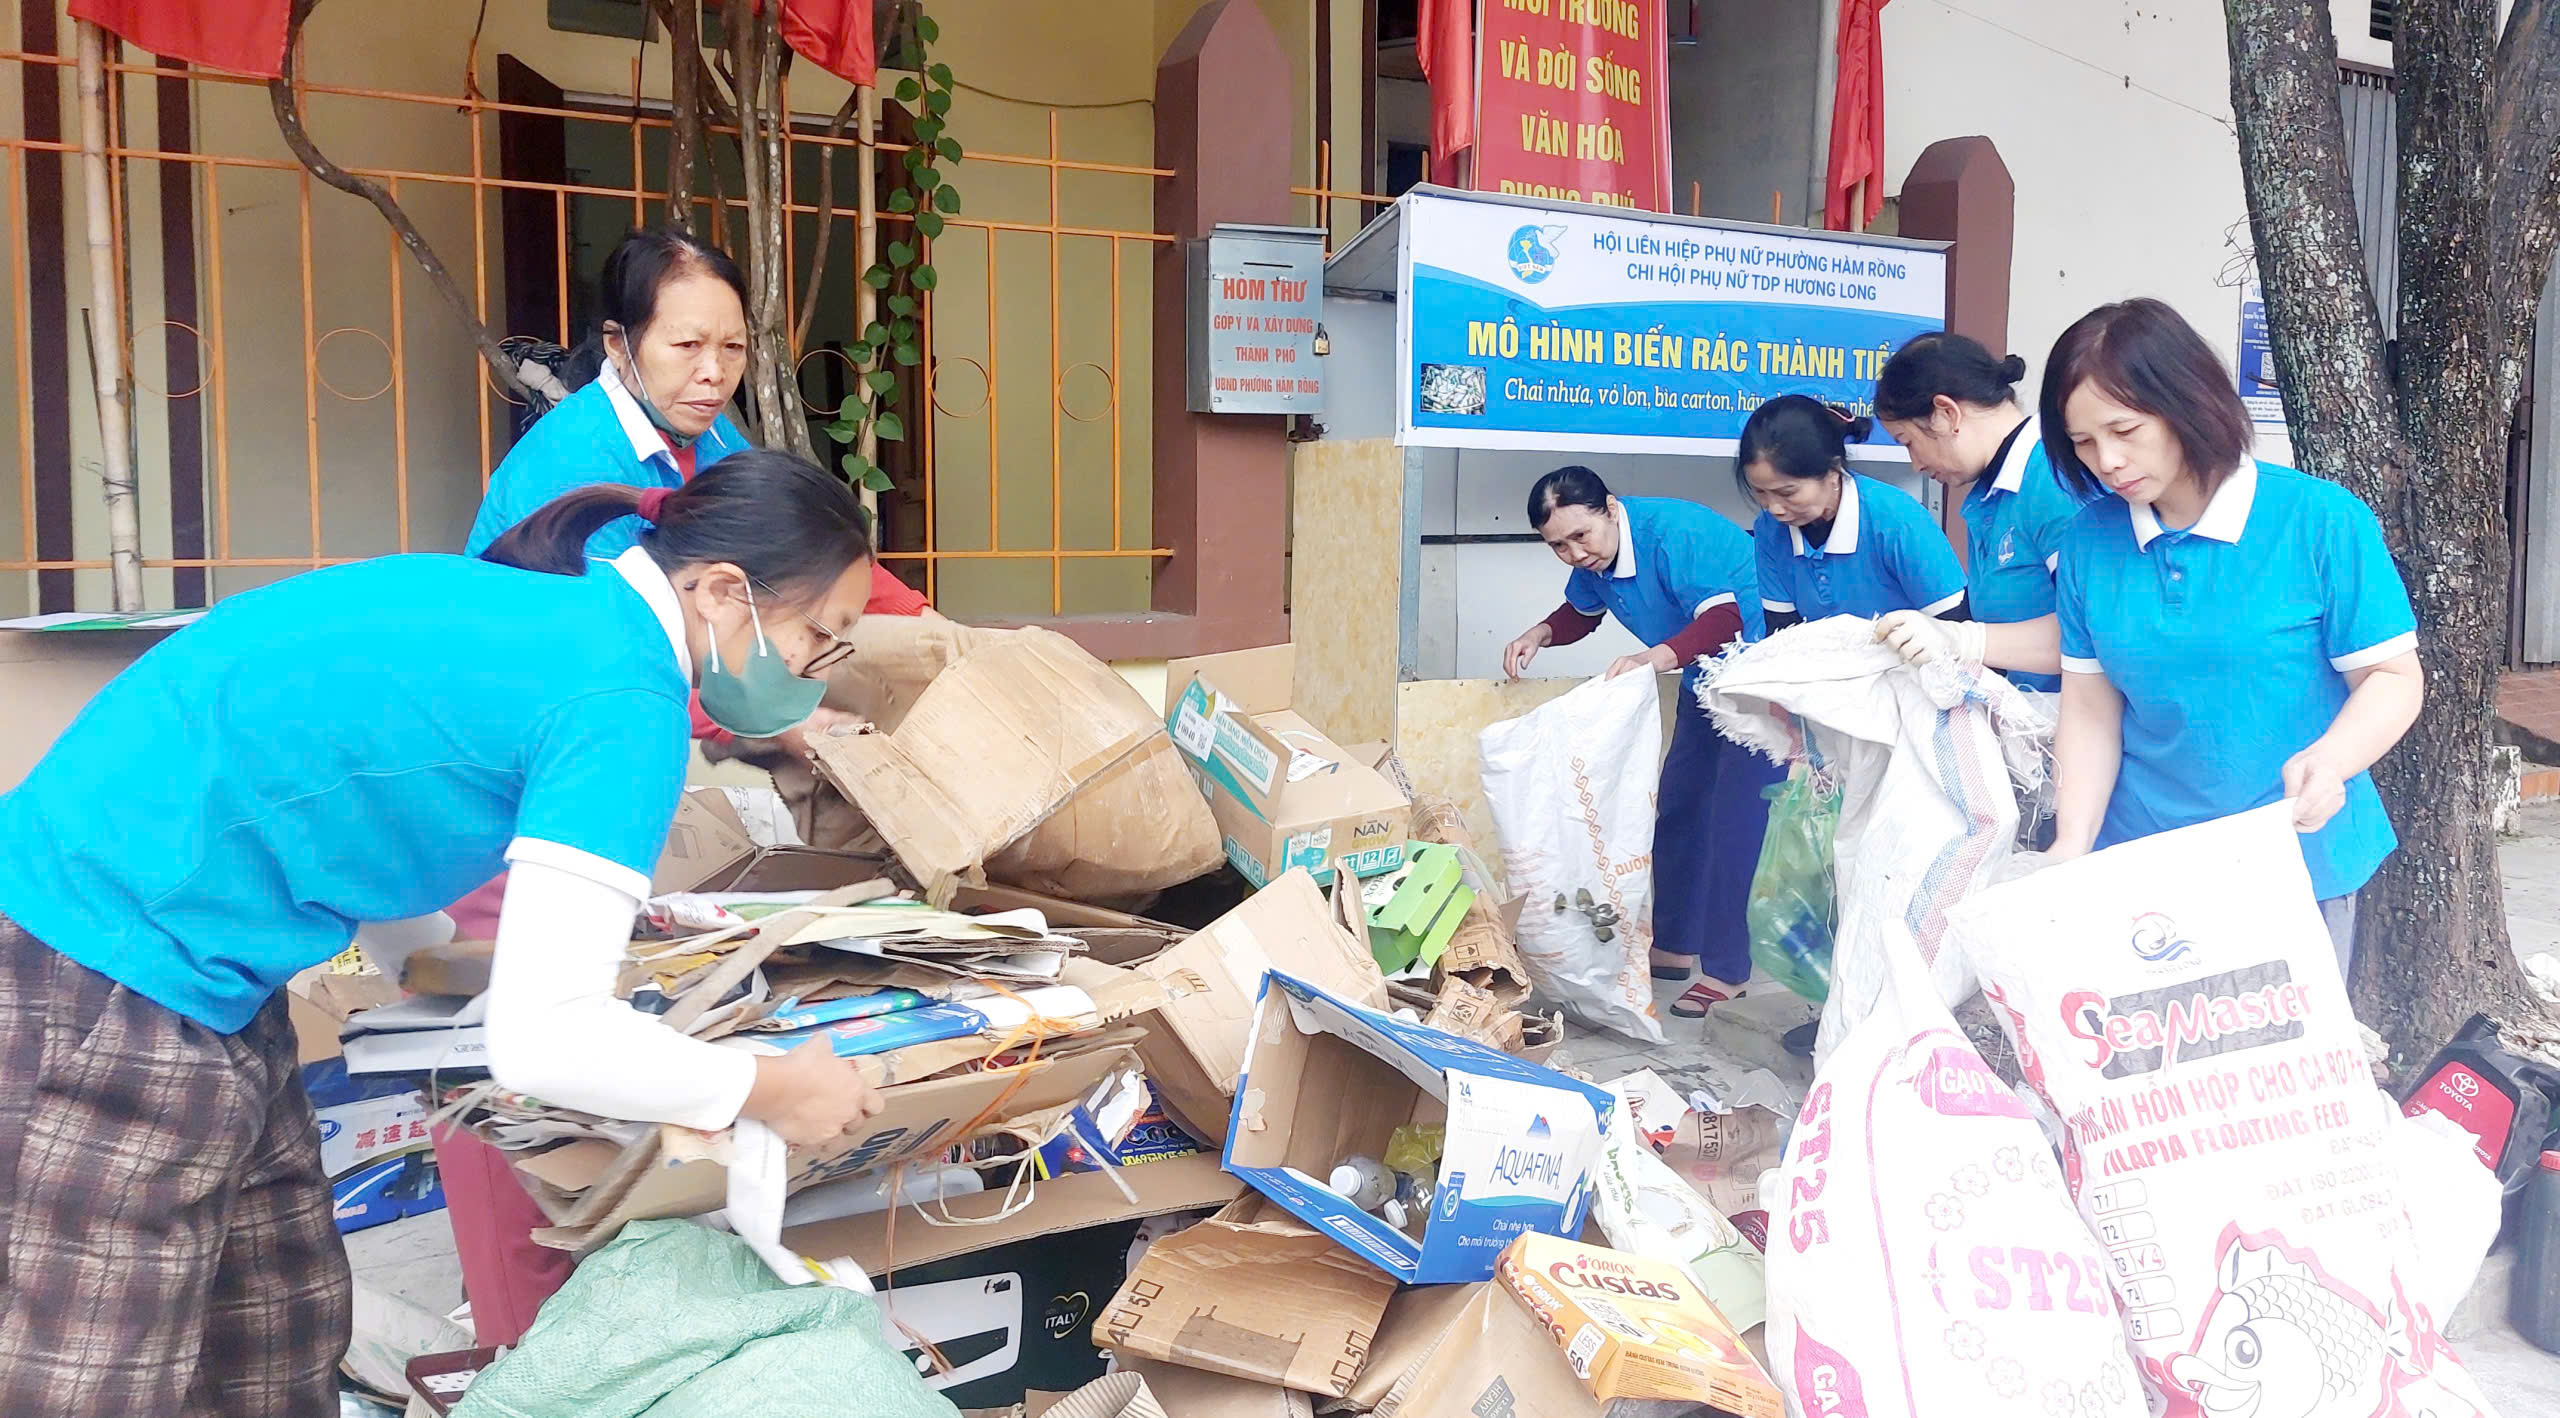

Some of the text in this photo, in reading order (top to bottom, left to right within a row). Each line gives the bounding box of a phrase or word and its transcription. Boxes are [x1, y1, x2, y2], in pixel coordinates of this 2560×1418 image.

[1500, 35, 1641, 105] VÀ ĐỜI SỐNG
[1521, 109, 1625, 165] VĂN HÓA
[1593, 231, 1906, 280] HỘI LIÊN HIỆP PHỤ NỮ PHƯỜNG HÀM RỒNG
[1627, 263, 1877, 300] CHI HỘI PHỤ NỮ TDP HƯƠNG LONG
[1468, 316, 1897, 381] MÔ HÌNH BIẾN RÁC THÀNH TIỀ
[1504, 377, 1543, 401] Chai
[1547, 379, 1594, 408] nhựa,
[1598, 384, 1619, 405] vỏ
[1623, 384, 1651, 410] lon,
[1655, 386, 1678, 408] bìa
[1681, 390, 1734, 416] carton,
[2060, 981, 2312, 1071] SeaMaster
[1459, 1081, 1472, 1097] 24
[2247, 1053, 2297, 1103] CHO
[2439, 1081, 2473, 1113] TOYOTA
[2190, 1109, 2312, 1156] FLOATING
[2312, 1100, 2350, 1132] FEED
[1489, 1144, 1564, 1190] AQUAFINA
[1789, 1081, 1833, 1254] ST25
[2473, 1145, 2492, 1161] OYOTA
[2093, 1193, 2110, 1209] T1
[1458, 1235, 1471, 1247] Cho
[1493, 1219, 1509, 1231] Chai
[2102, 1225, 2119, 1241] T2
[1549, 1262, 1681, 1301] Custas
[1589, 1258, 1637, 1276] ORION
[1968, 1246, 2109, 1318] ST25
[1045, 1311, 1079, 1329] ITALY
[1480, 1383, 1504, 1413] HEAVY
[1812, 1364, 1845, 1418] GẠ
